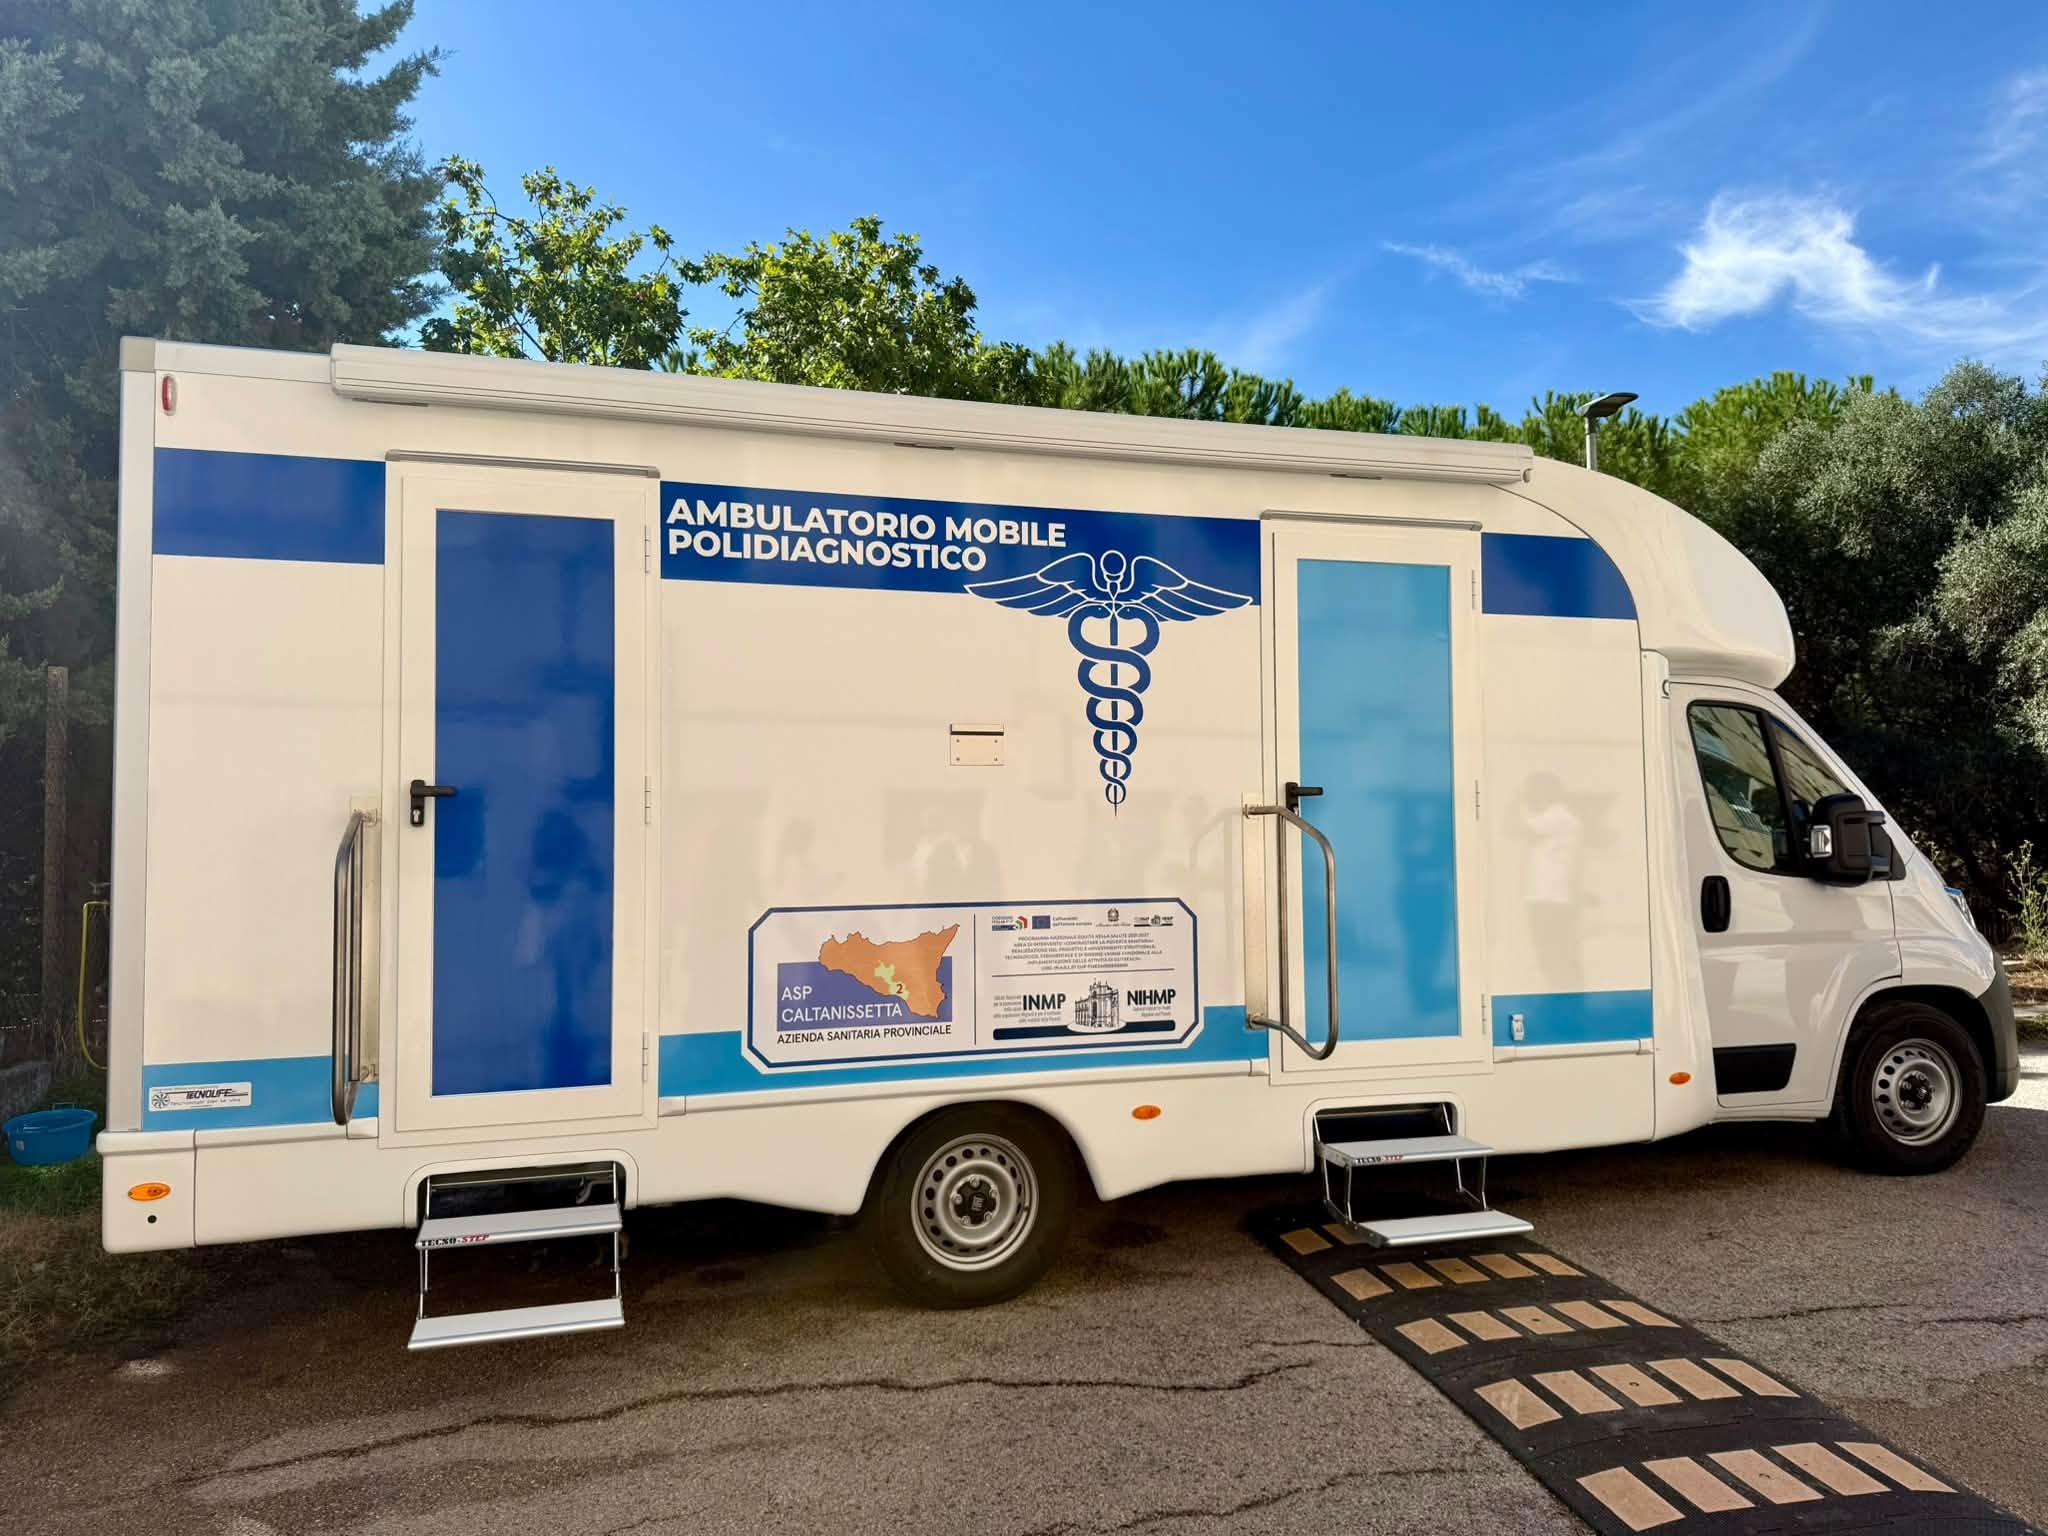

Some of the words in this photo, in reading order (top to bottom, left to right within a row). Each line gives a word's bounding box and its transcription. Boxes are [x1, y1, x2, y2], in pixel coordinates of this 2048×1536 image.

[667, 499, 936, 540] AMBULATORIO
[945, 517, 1067, 548] MOBILE
[668, 529, 987, 573] POLIDIAGNOSTICO
[781, 986, 812, 1001] ASP
[896, 984, 904, 994] 2
[1127, 989, 1176, 1006] NIHMP
[1023, 993, 1066, 1011] INMP
[781, 1003, 903, 1023] CALTANISSETTA
[777, 1032, 825, 1044] AZIENDA
[827, 1029, 881, 1042] SANITARIA
[883, 1024, 952, 1038] PROVINCIALE
[186, 1089, 232, 1099] TECNOLIFE
